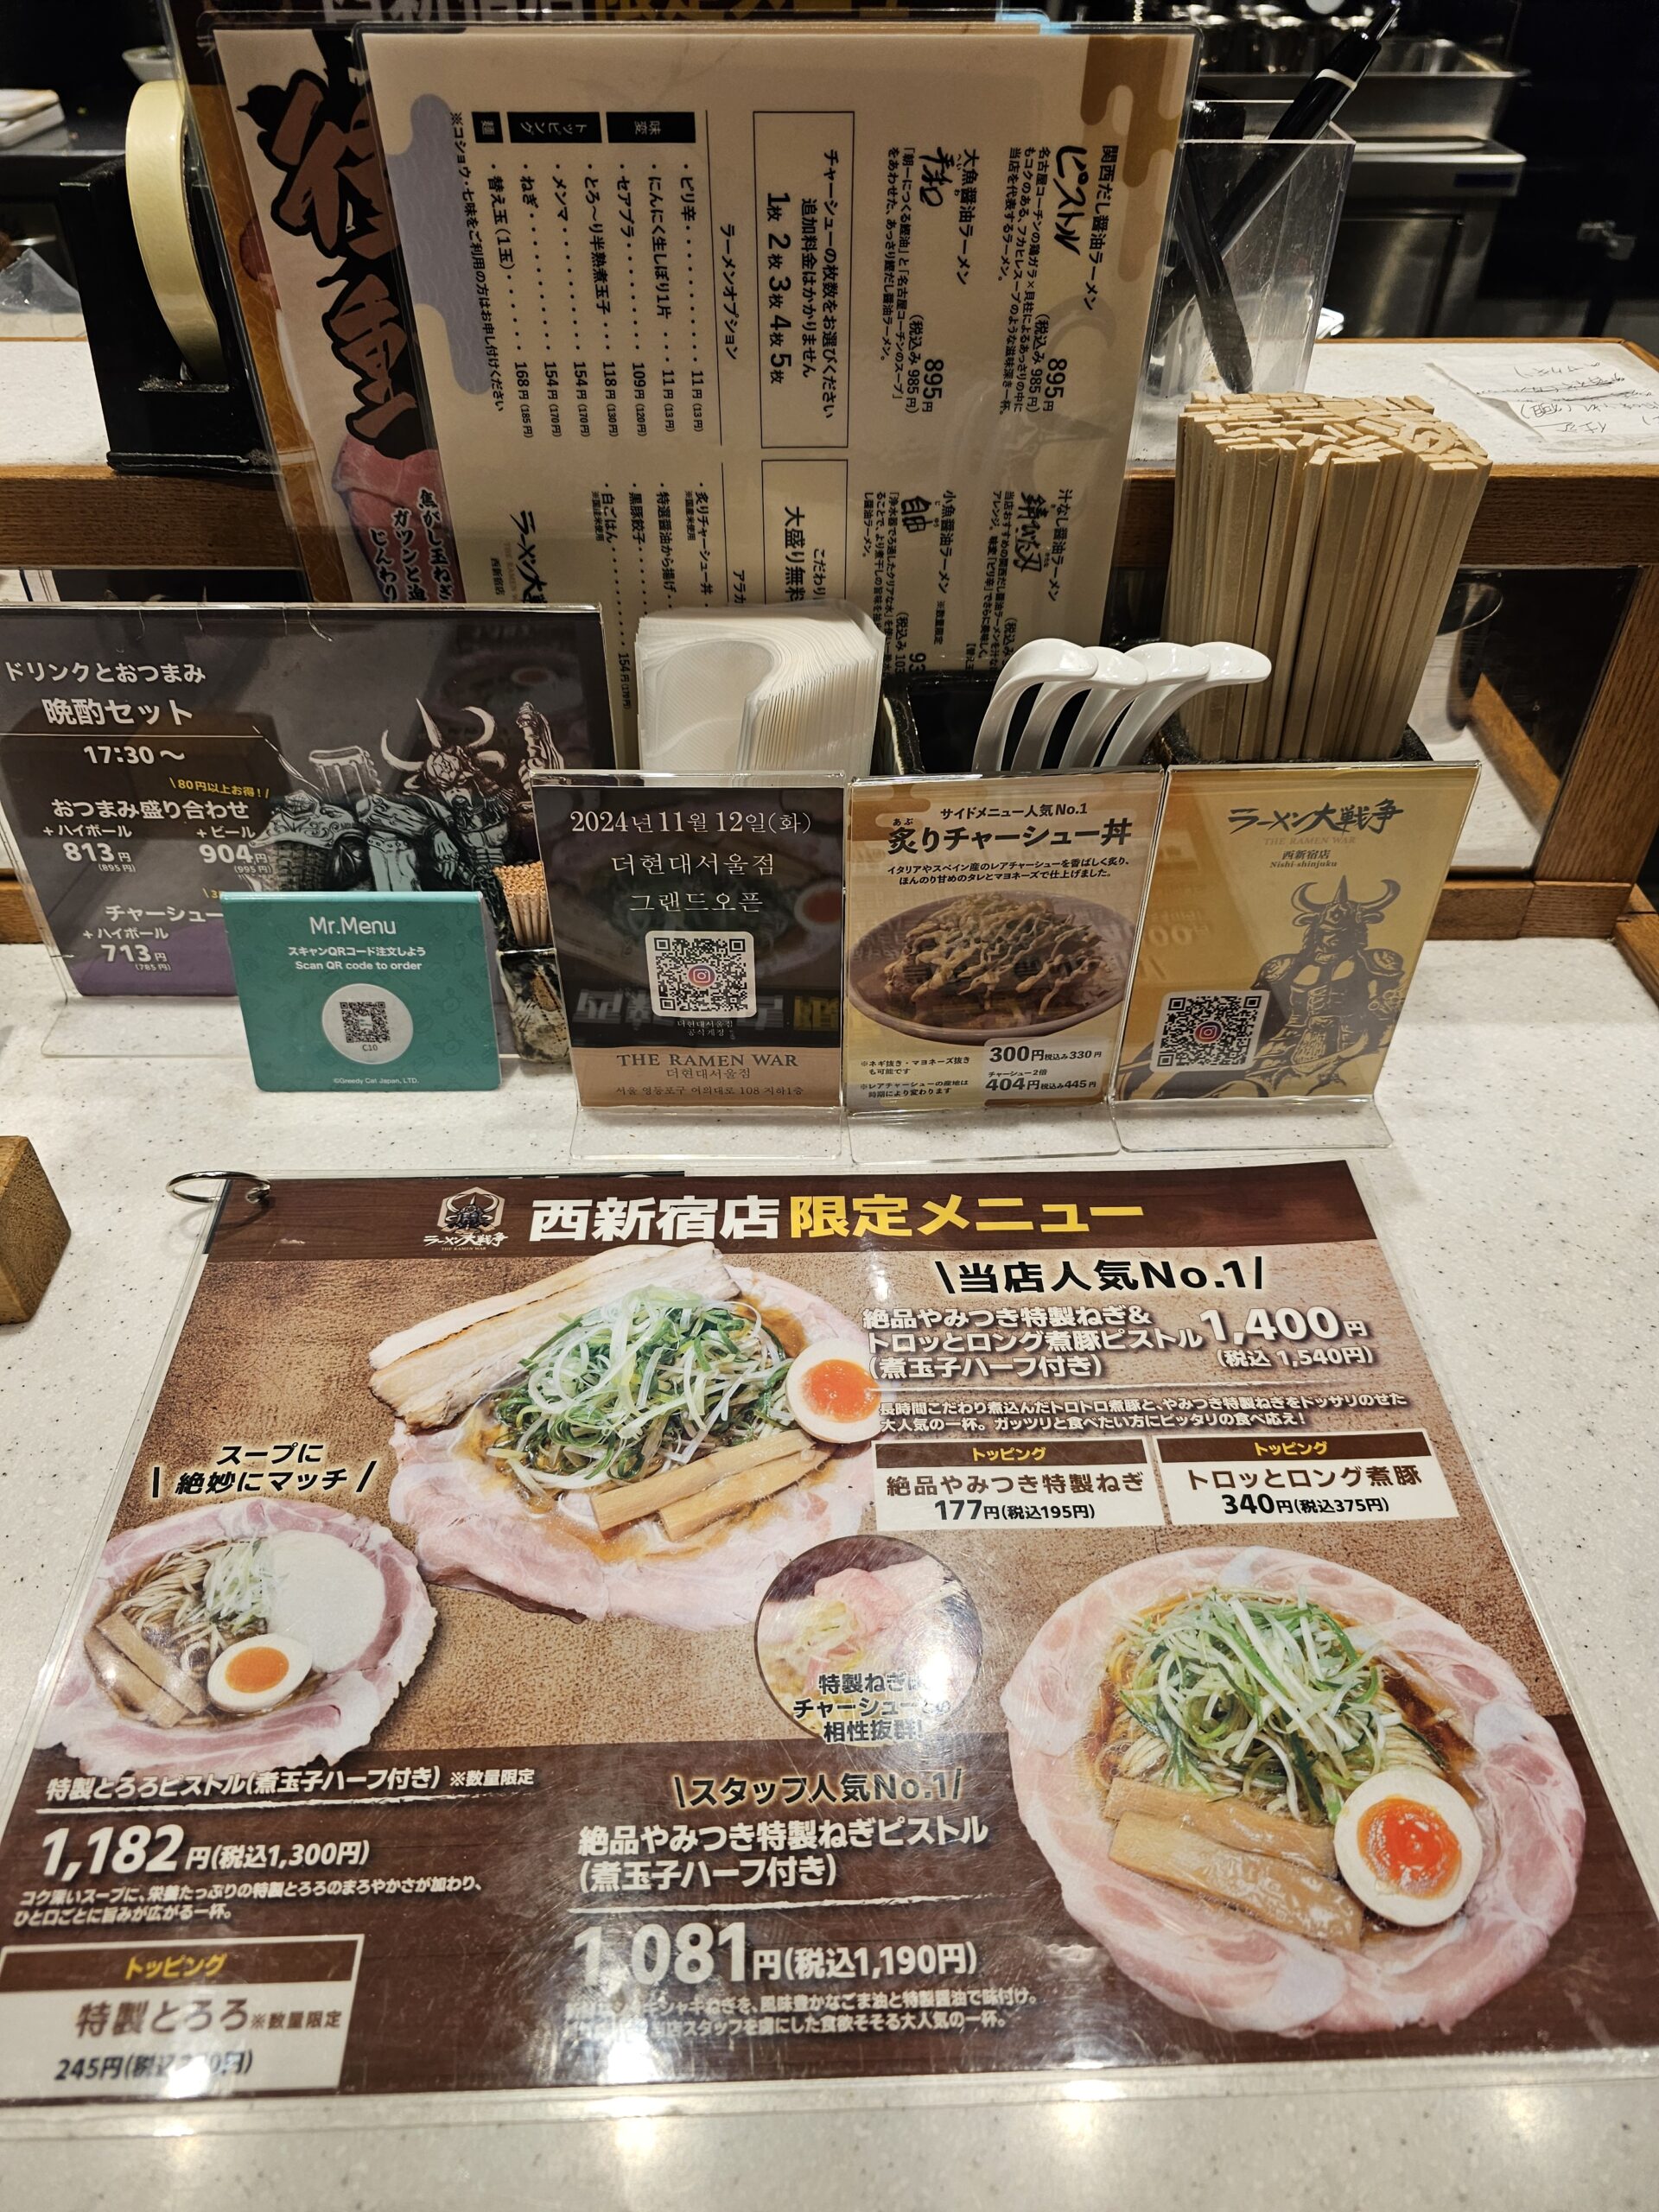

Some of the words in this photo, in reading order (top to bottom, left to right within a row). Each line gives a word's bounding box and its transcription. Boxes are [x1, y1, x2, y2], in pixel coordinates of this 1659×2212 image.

[551, 176, 569, 222] メンマ
[1052, 145, 1088, 255] ピストル
[955, 149, 978, 285] 大魚醤油ラーメン
[1083, 145, 1118, 311] 関西だし醤油ラーメン
[720, 224, 737, 359] ラーメンオプション
[800, 198, 817, 378] 追加料金はかかりません
[821, 149, 838, 418] チャーシューの枚数をお選びください
[921, 359, 944, 412] 895円
[1041, 358, 1066, 411] 895円
[937, 490, 956, 594] 小魚醤油ラーメン
[1046, 489, 1071, 601] 汁なし醤油ラーメン
[811, 549, 825, 601] こだわり
[5, 661, 206, 683] ドリンクとおつまみ
[41, 697, 193, 725] 晩酌セット
[52, 798, 250, 820] おつまみ盛り合わせ
[940, 802, 1088, 820] サイドメニュー人気No.1
[1228, 798, 1404, 835] ラーメン大戦争
[887, 818, 1132, 855] 炙りチャーシュー丼
[1332, 836, 1357, 844] WAR
[612, 853, 774, 876] 더현대서울점
[1282, 849, 1331, 861] 西新宿店
[630, 892, 764, 912] 그랜드오픈
[309, 916, 397, 935] Mr.Menu
[289, 947, 426, 957] スキャンQRコード注文しよう
[296, 961, 323, 969] Scan
[327, 961, 343, 970] QR
[346, 961, 373, 969] code
[391, 961, 422, 969] order
[617, 1053, 659, 1066] THE
[669, 1053, 744, 1067] RAMEN
[752, 1053, 798, 1066] WAR
[868, 1327, 1203, 1354] トロッとロング煮豚ピストル
[868, 1353, 1102, 1379] (煮玉子ハーフ付き)
[216, 1442, 324, 1465] スープに
[972, 1445, 1046, 1463] トッピング
[1254, 1440, 1328, 1457] トッピング
[175, 1469, 347, 1495] 絶妙にマッチ
[887, 1471, 1145, 1497] 絶品やみつき特製ねぎ
[1188, 1465, 1422, 1491] トロッとロング煮豚
[577, 1816, 988, 1857] 絶品やみつき特製ねぎピストル
[580, 1854, 836, 1893] (煮玉子ハーフ付き)
[124, 1954, 228, 1980] トッピング
[574, 1922, 977, 1986] 1081円(税込1,190円)
